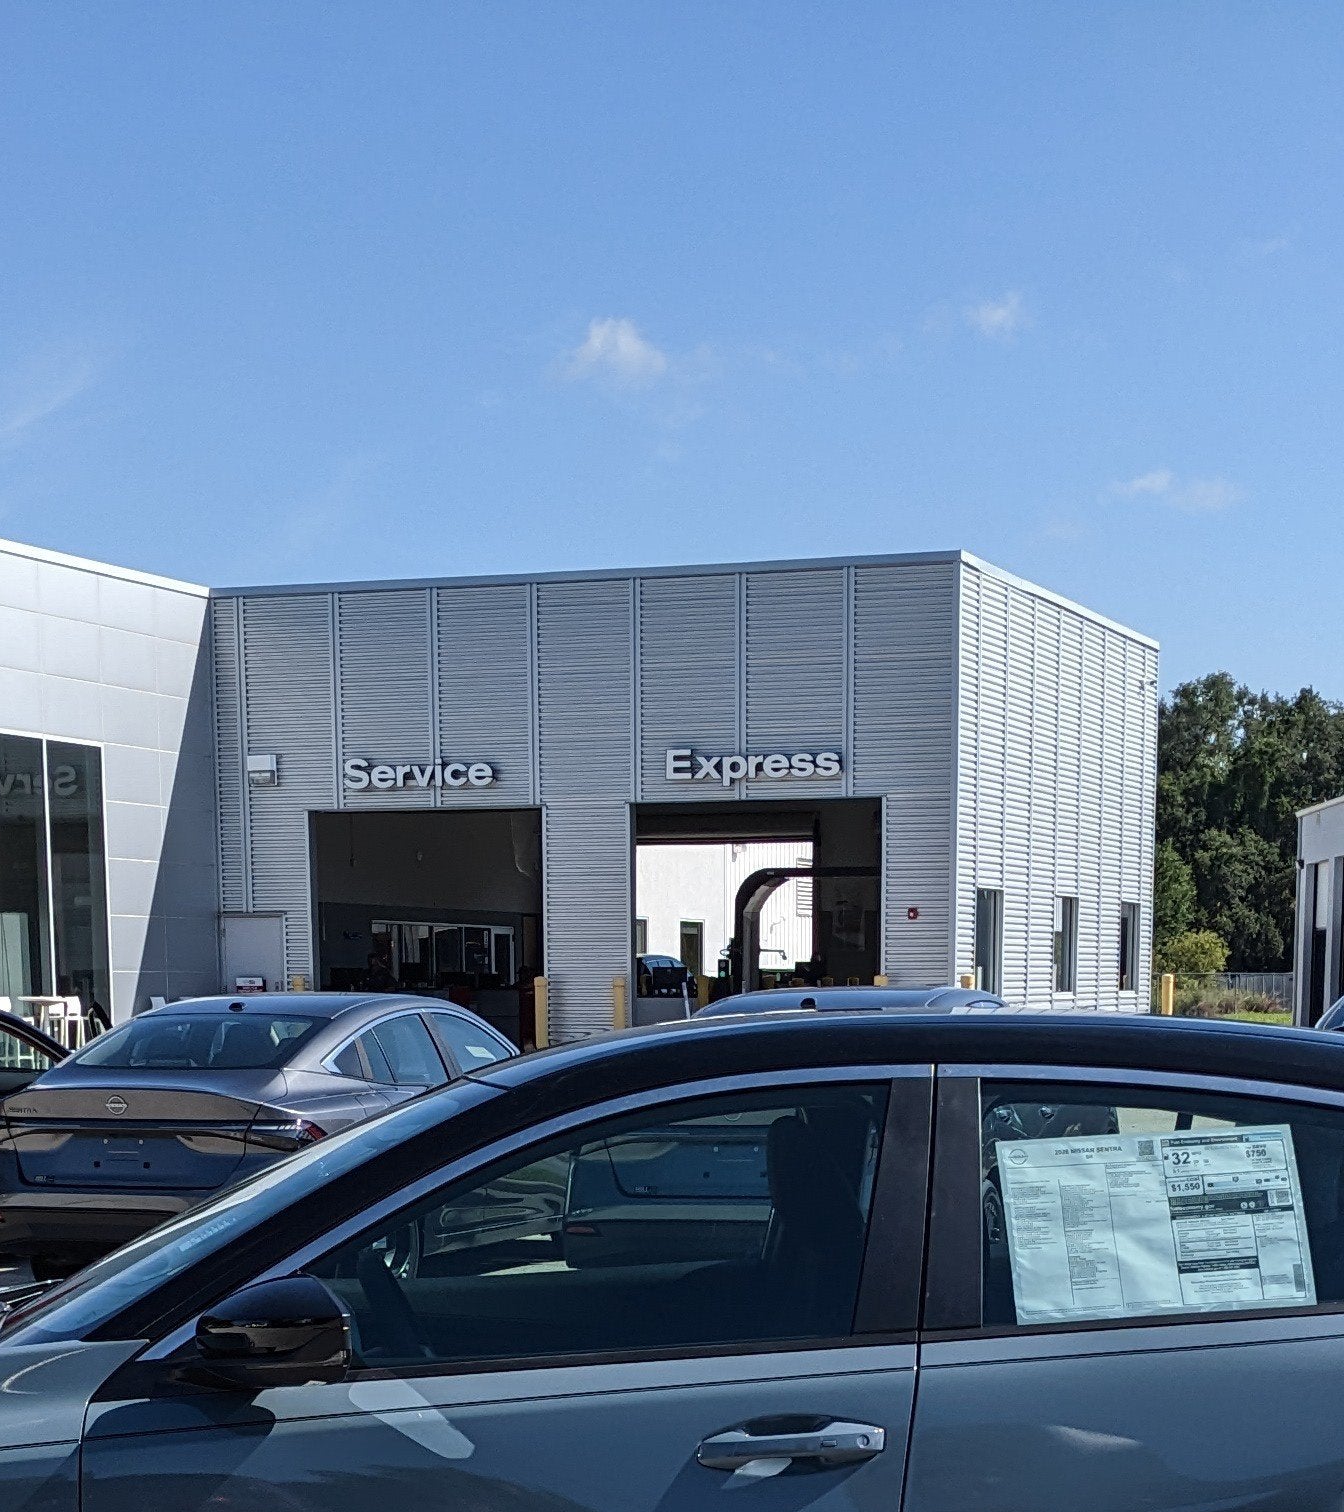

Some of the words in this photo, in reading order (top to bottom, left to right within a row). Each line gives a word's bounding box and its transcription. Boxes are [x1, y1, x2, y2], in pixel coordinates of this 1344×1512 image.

[343, 758, 495, 790] Service
[666, 749, 842, 787] Express
[1171, 1151, 1191, 1165] 32
